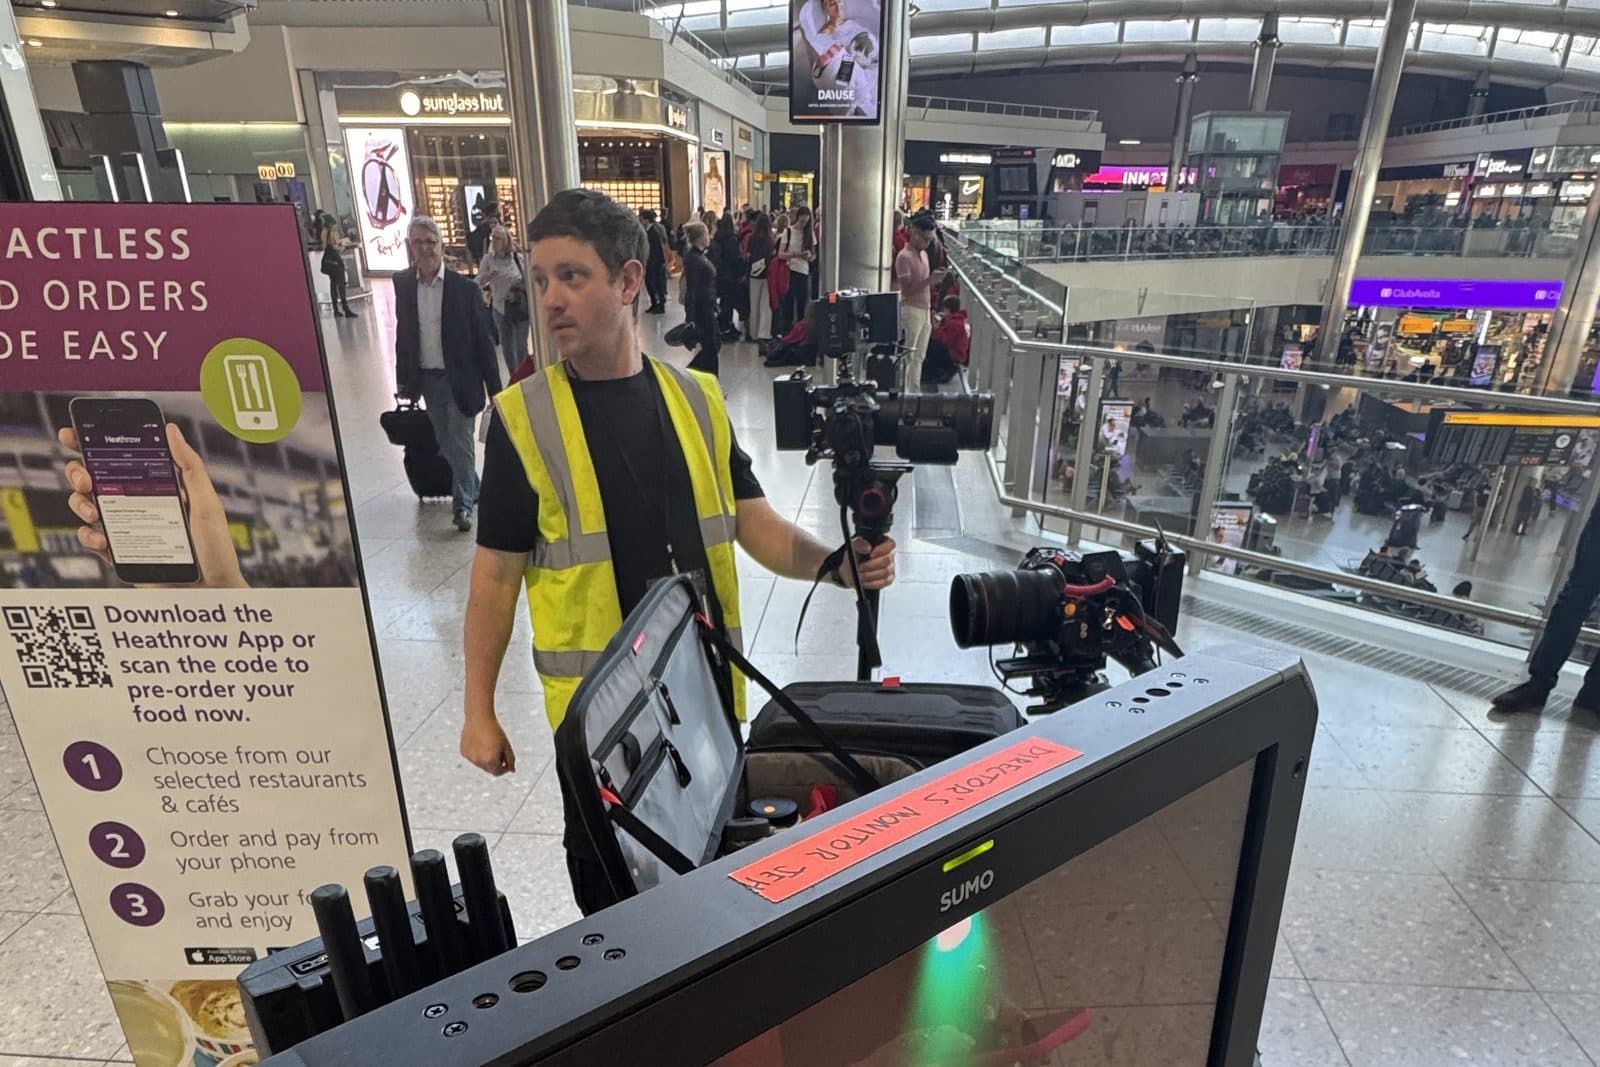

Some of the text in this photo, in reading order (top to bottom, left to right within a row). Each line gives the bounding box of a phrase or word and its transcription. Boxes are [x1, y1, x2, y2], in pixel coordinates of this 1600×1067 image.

[423, 92, 504, 115] sunglass hut
[5, 227, 191, 261] ACTLESS
[43, 279, 208, 311] ORDERS
[63, 330, 167, 360] EASY
[104, 604, 273, 623] Download the
[112, 630, 316, 653] Heathrow App or
[120, 655, 309, 674] scan the code to
[128, 680, 295, 703] pre-order your
[132, 705, 251, 722] food now.
[81, 753, 101, 780] 1
[146, 745, 332, 766] Choose from our
[153, 770, 368, 790] selected restaurants
[161, 794, 240, 814] & cafés
[170, 828, 379, 851] Order and pay from
[806, 806, 922, 861] MONITOR
[104, 833, 130, 858] 2
[175, 852, 296, 874] your phone
[188, 889, 313, 911] Grab your fo
[940, 869, 994, 912] SUMO
[125, 893, 149, 917] 3
[195, 911, 293, 932] and enjoy
[208, 954, 252, 963] App Store
